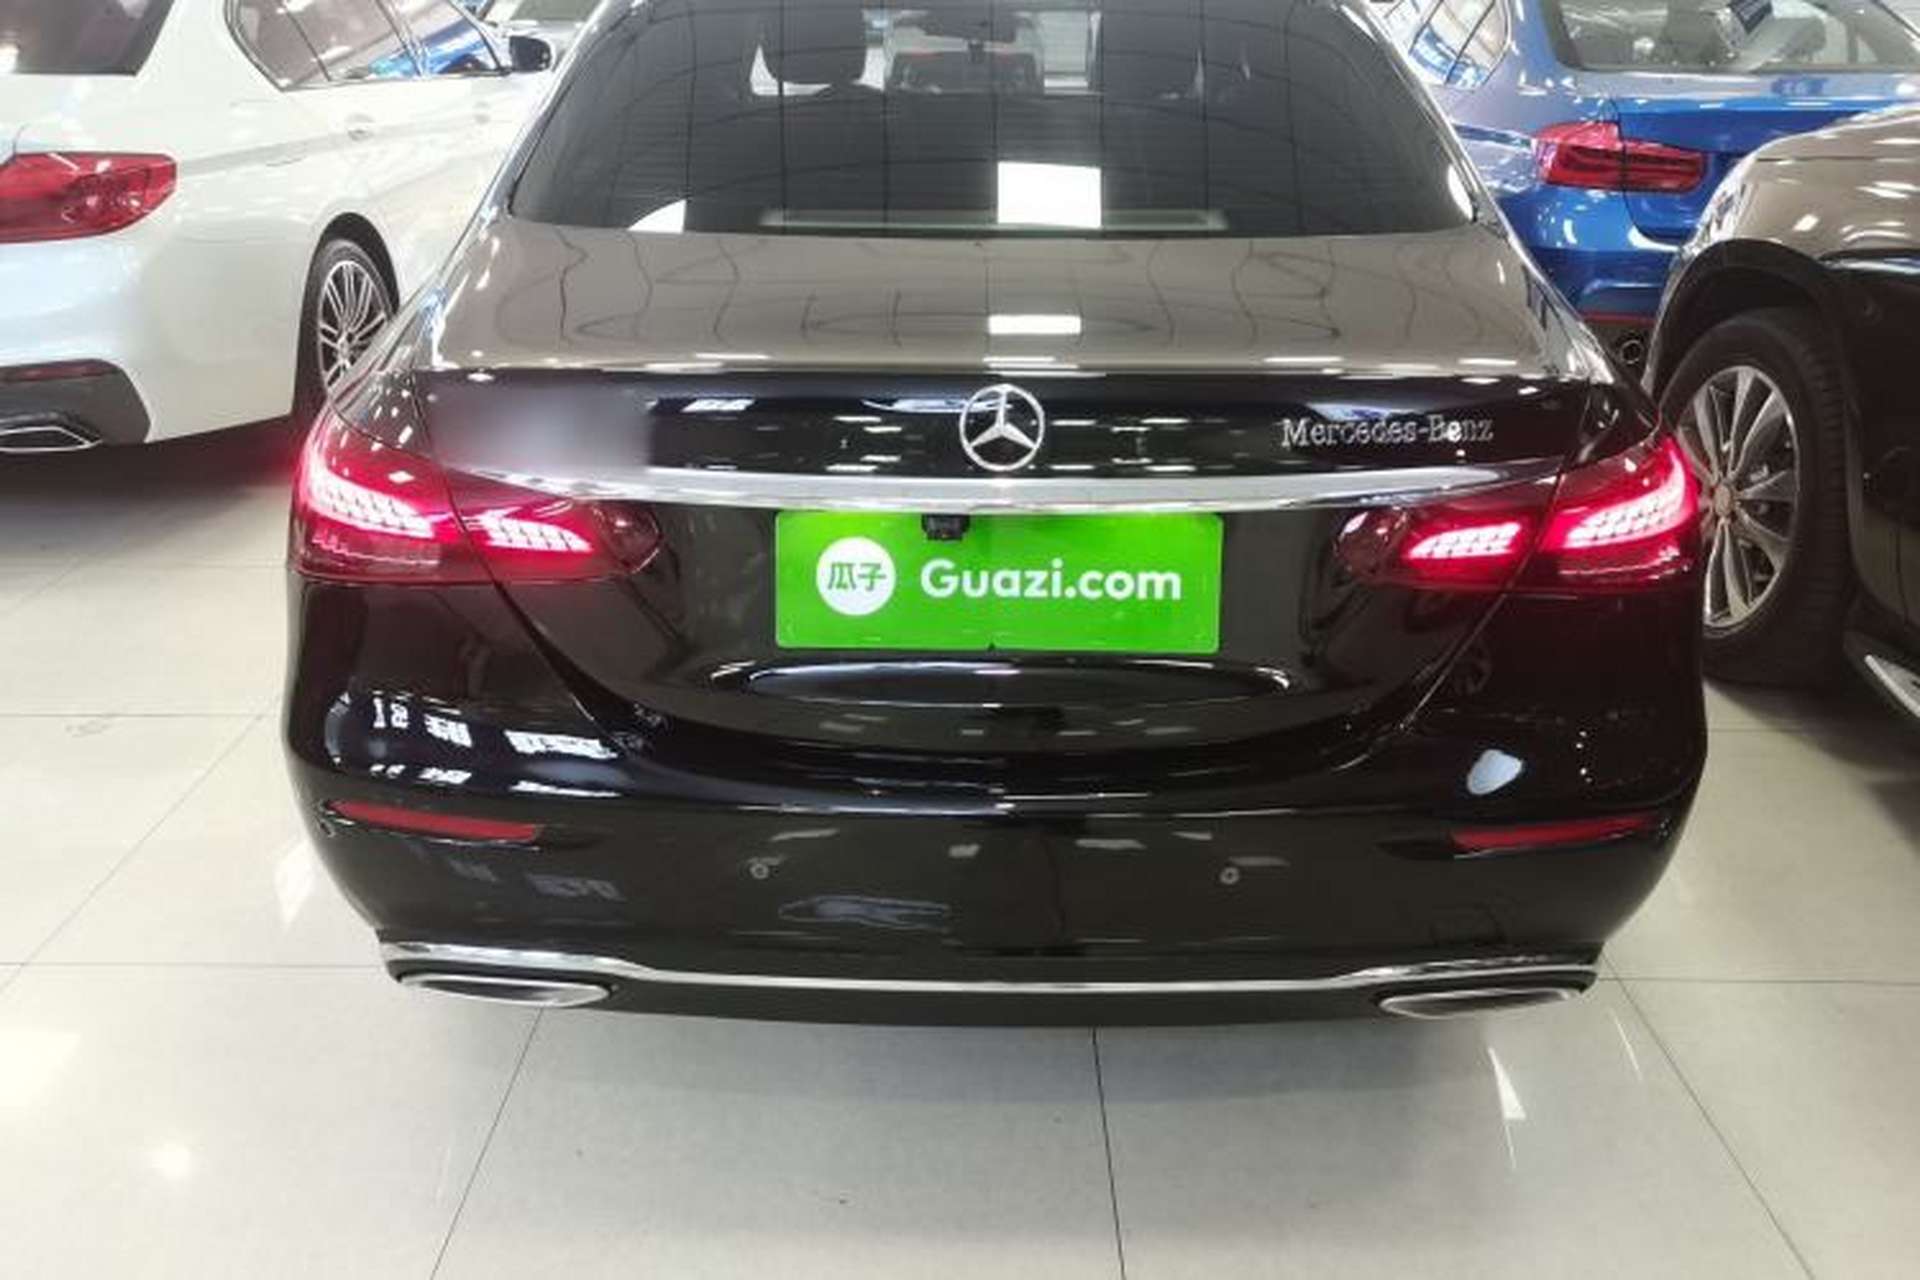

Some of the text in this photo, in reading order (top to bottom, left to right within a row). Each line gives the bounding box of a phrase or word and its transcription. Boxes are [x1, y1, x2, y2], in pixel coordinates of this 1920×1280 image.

[1280, 414, 1493, 447] Mercedes-Benz
[828, 562, 886, 592] 瓜子
[920, 558, 1181, 600] Guazi.com
